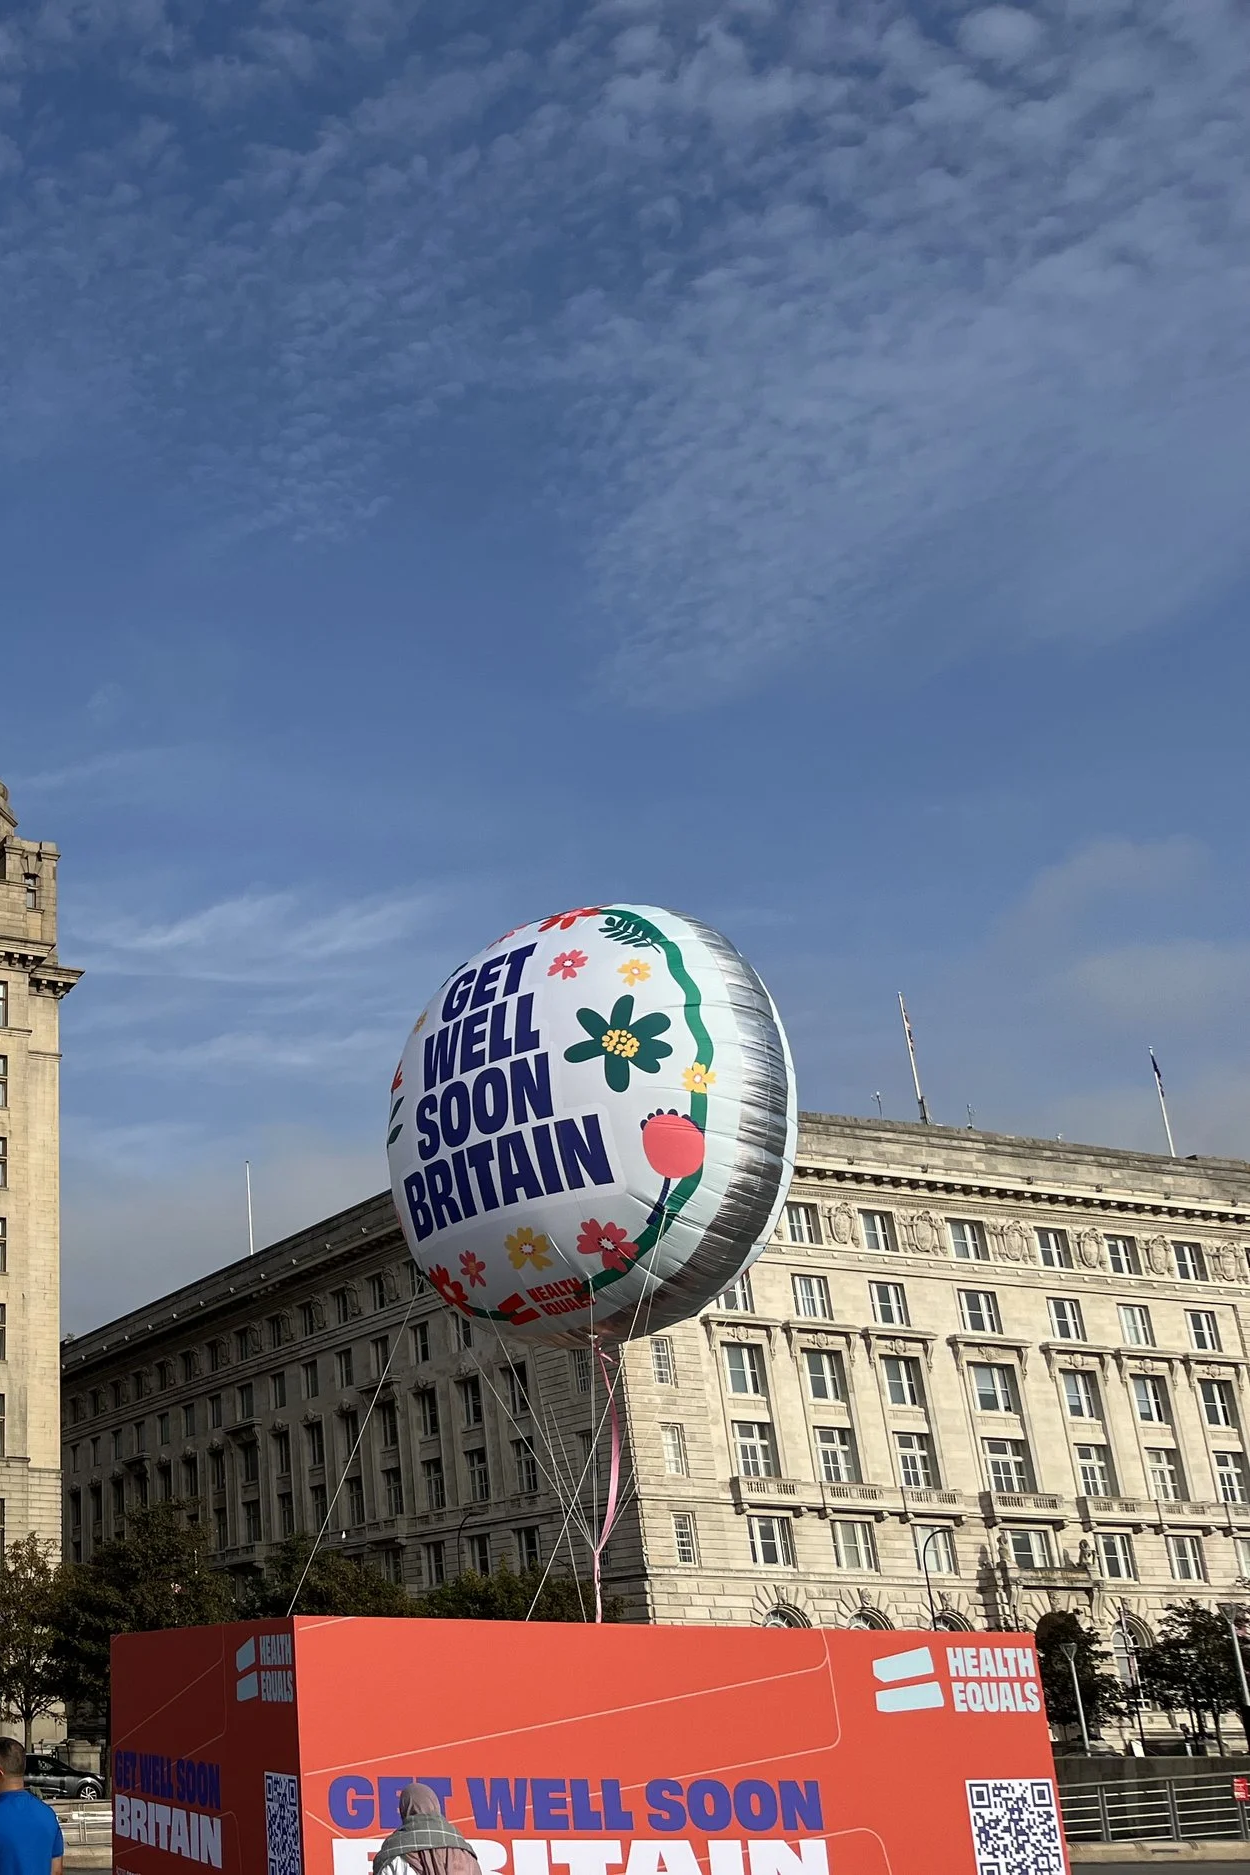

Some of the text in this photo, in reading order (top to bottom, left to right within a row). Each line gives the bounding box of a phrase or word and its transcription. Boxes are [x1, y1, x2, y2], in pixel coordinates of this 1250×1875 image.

[441, 942, 538, 1023] GET
[423, 994, 541, 1093] WELL
[415, 1051, 554, 1161] SOON
[403, 1113, 615, 1243] BRITAIN
[259, 1633, 292, 1666] HEALTH
[946, 1647, 1036, 1677] HEALTH
[260, 1670, 294, 1702] EQUALS
[951, 1681, 1041, 1712] EQUALS
[115, 1748, 222, 1811] GET WELL SOON
[466, 1777, 634, 1831] WELL
[646, 1778, 824, 1832] SOON
[115, 1794, 222, 1869] BRITAIN
[332, 1838, 830, 1875] ITAIN
